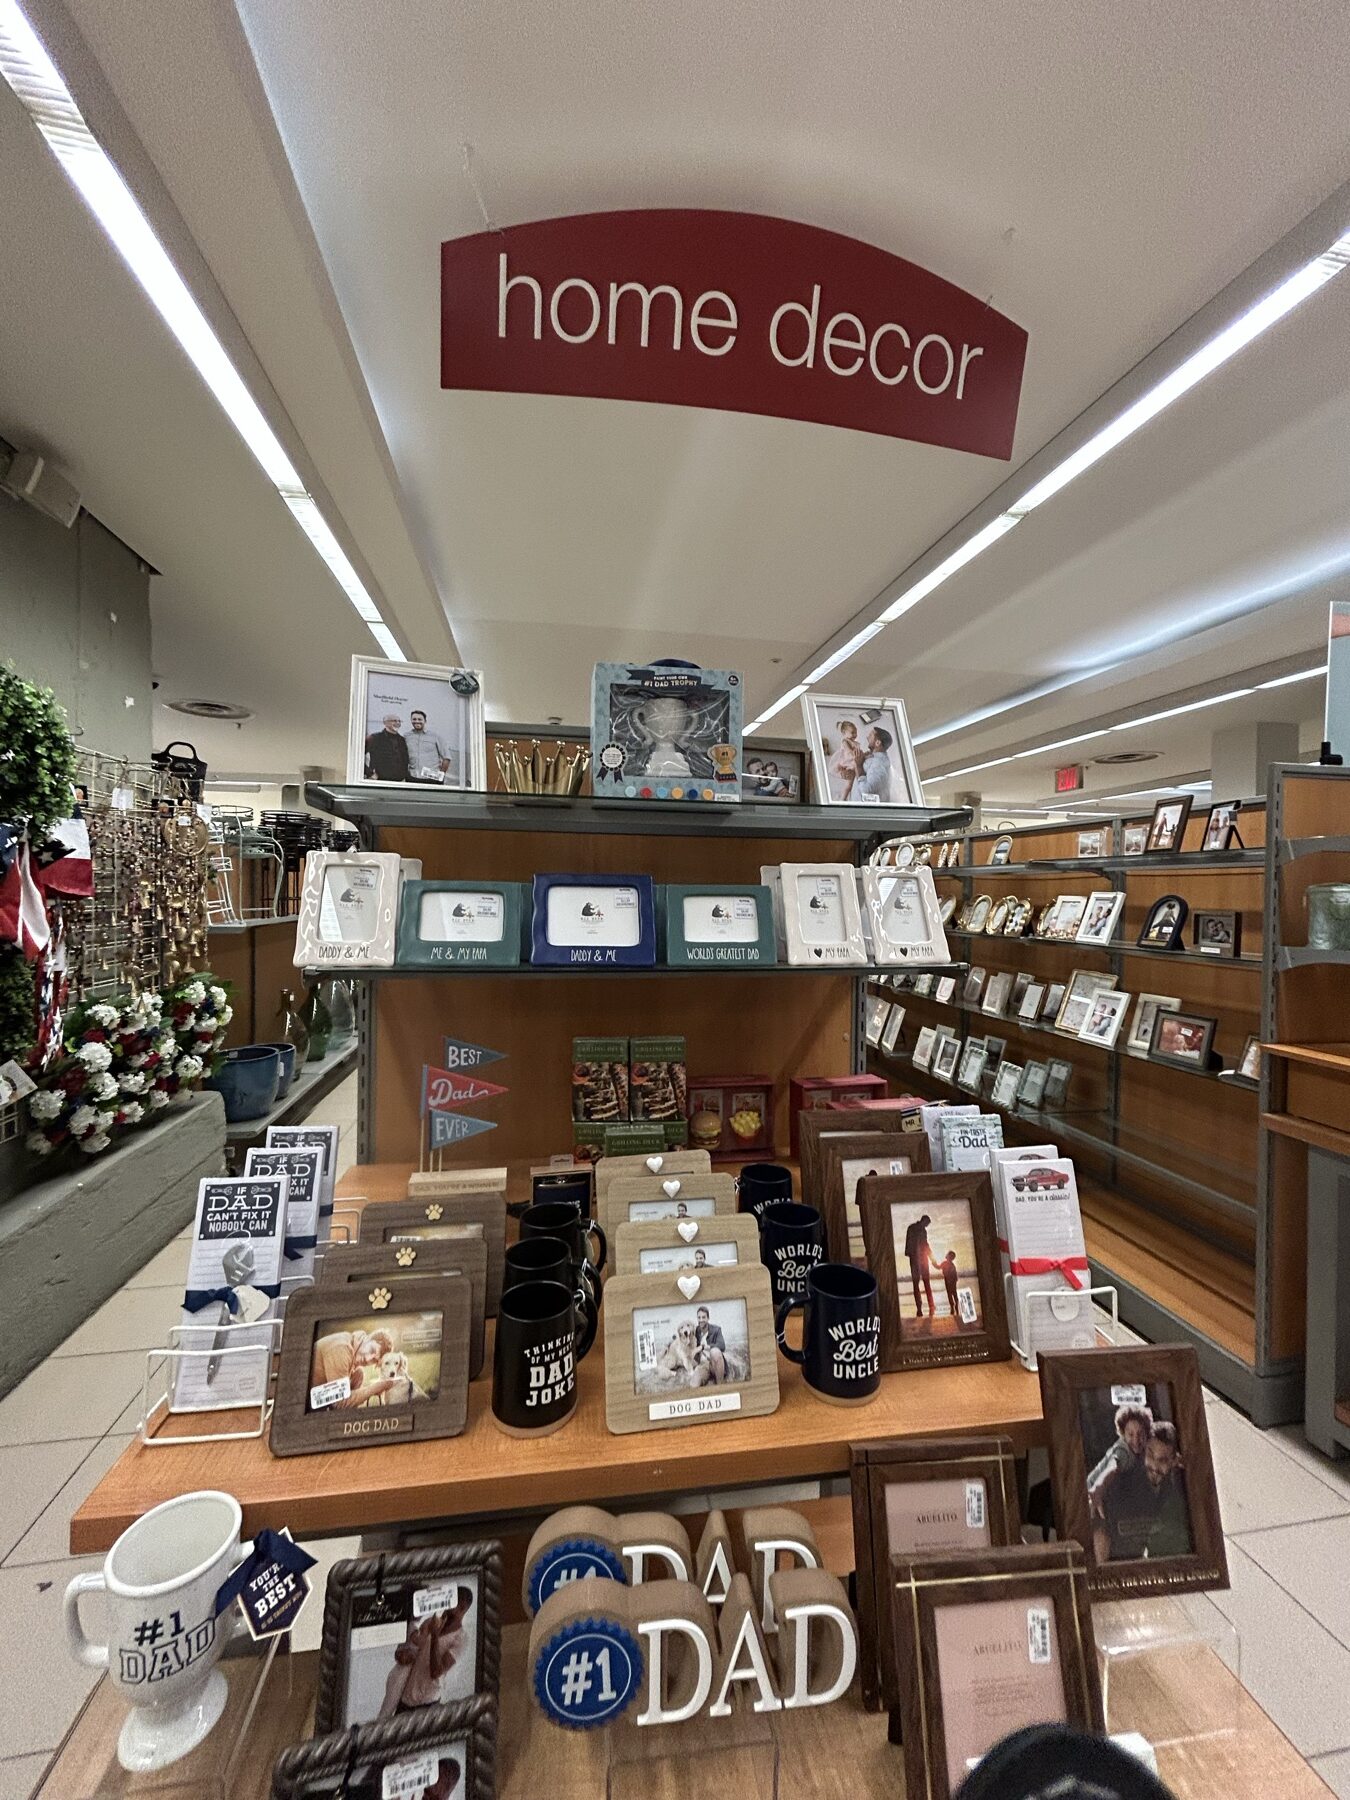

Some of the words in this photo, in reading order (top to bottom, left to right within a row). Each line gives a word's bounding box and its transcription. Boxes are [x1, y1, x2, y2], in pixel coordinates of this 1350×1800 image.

[498, 253, 738, 356] home
[769, 284, 984, 400] decor
[318, 946, 342, 959] DADDY
[344, 947, 354, 959] &
[357, 946, 370, 959] ME
[430, 947, 443, 960] ME
[445, 947, 455, 960] &
[457, 947, 470, 960] MY
[472, 947, 487, 960] PAPA
[570, 949, 592, 962] DADDY
[593, 949, 603, 962] &
[605, 949, 617, 962] ME
[686, 947, 714, 960] WORLD'S
[715, 947, 745, 960] GREATEST
[747, 948, 760, 960] DAD
[825, 948, 835, 958] MY
[836, 948, 851, 958] PAPA
[910, 947, 920, 958] MY
[921, 947, 935, 957] PAPA
[448, 1045, 482, 1068] BEST
[428, 1078, 489, 1107] Dad
[435, 1117, 470, 1141] EVER
[958, 1134, 989, 1149] Dad
[279, 1156, 288, 1164] IF
[254, 1163, 311, 1177] DAD
[237, 1186, 247, 1195] IF
[300, 1178, 309, 1186] IT
[289, 1186, 306, 1196] CAN
[207, 1194, 273, 1211] DAD
[206, 1212, 239, 1221] CAN'T
[241, 1211, 258, 1219] FIX
[261, 1210, 272, 1219] IT
[208, 1220, 246, 1233] NOBODY
[248, 1220, 268, 1231] CAN
[774, 1243, 823, 1261] WORLD'S
[777, 1279, 805, 1293] UNC
[531, 1355, 541, 1365] OF
[544, 1352, 556, 1363] MY
[558, 1341, 573, 1357] NEXT
[833, 1334, 879, 1362] Best
[529, 1351, 574, 1388] DAD
[833, 1356, 879, 1380] UNCLE
[525, 1373, 575, 1407] JOKE
[669, 1403, 692, 1415] DOG
[698, 1399, 723, 1411] DAD
[343, 1420, 370, 1435] DOG
[373, 1418, 399, 1432] DAD
[916, 1513, 958, 1524] ABUELITO
[249, 1562, 284, 1592] YOU'R
[254, 1572, 296, 1618] BEST
[622, 1540, 822, 1633] DAD
[134, 1610, 186, 1647] #1
[119, 1617, 216, 1685] DAD
[561, 1647, 617, 1707] #1
[636, 1604, 857, 1726] DAD
